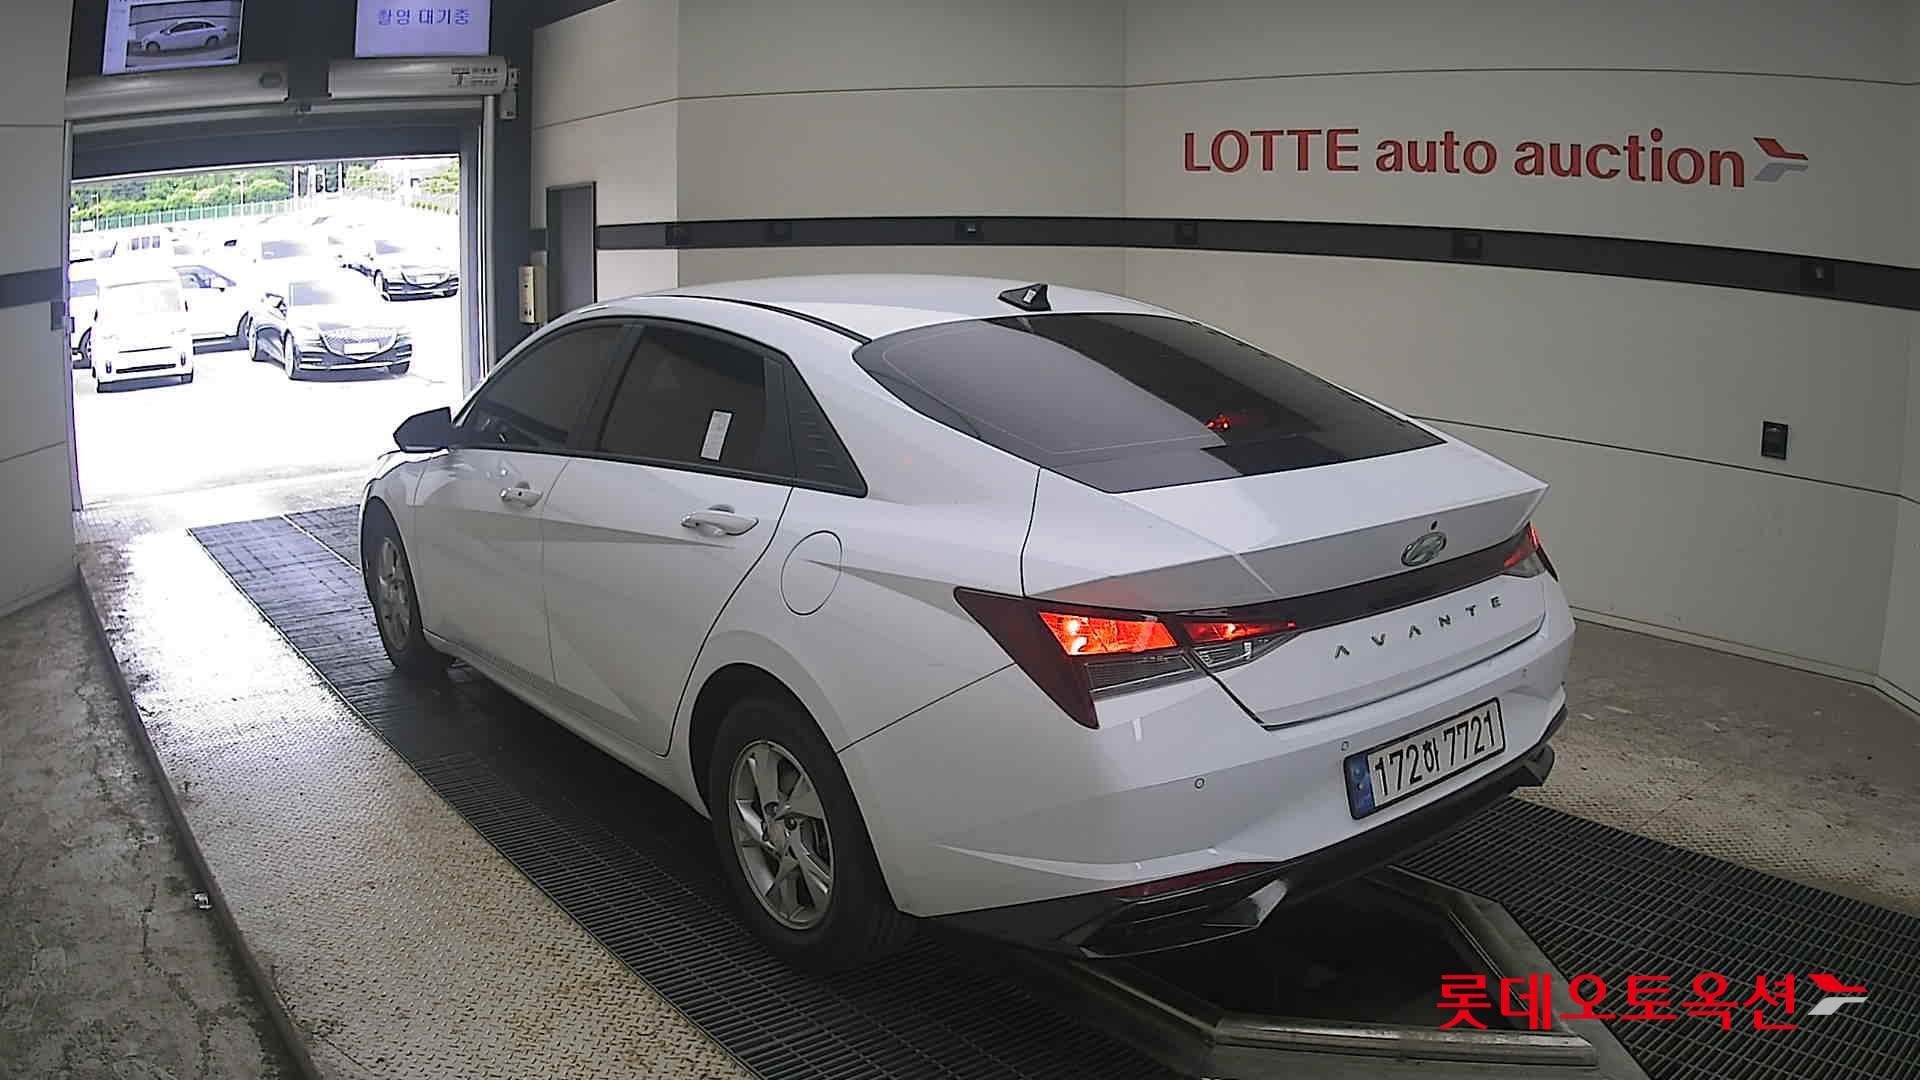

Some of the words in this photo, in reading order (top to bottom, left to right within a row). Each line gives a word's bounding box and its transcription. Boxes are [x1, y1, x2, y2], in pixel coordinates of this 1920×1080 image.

[418, 8, 471, 26] 대기중
[1184, 128, 1360, 173] LOTTE
[1375, 130, 1498, 176] auto
[1513, 127, 1746, 188] auction
[1334, 596, 1502, 660] AVANTE
[1373, 737, 1441, 797] 172하
[1442, 710, 1496, 767] 7721
